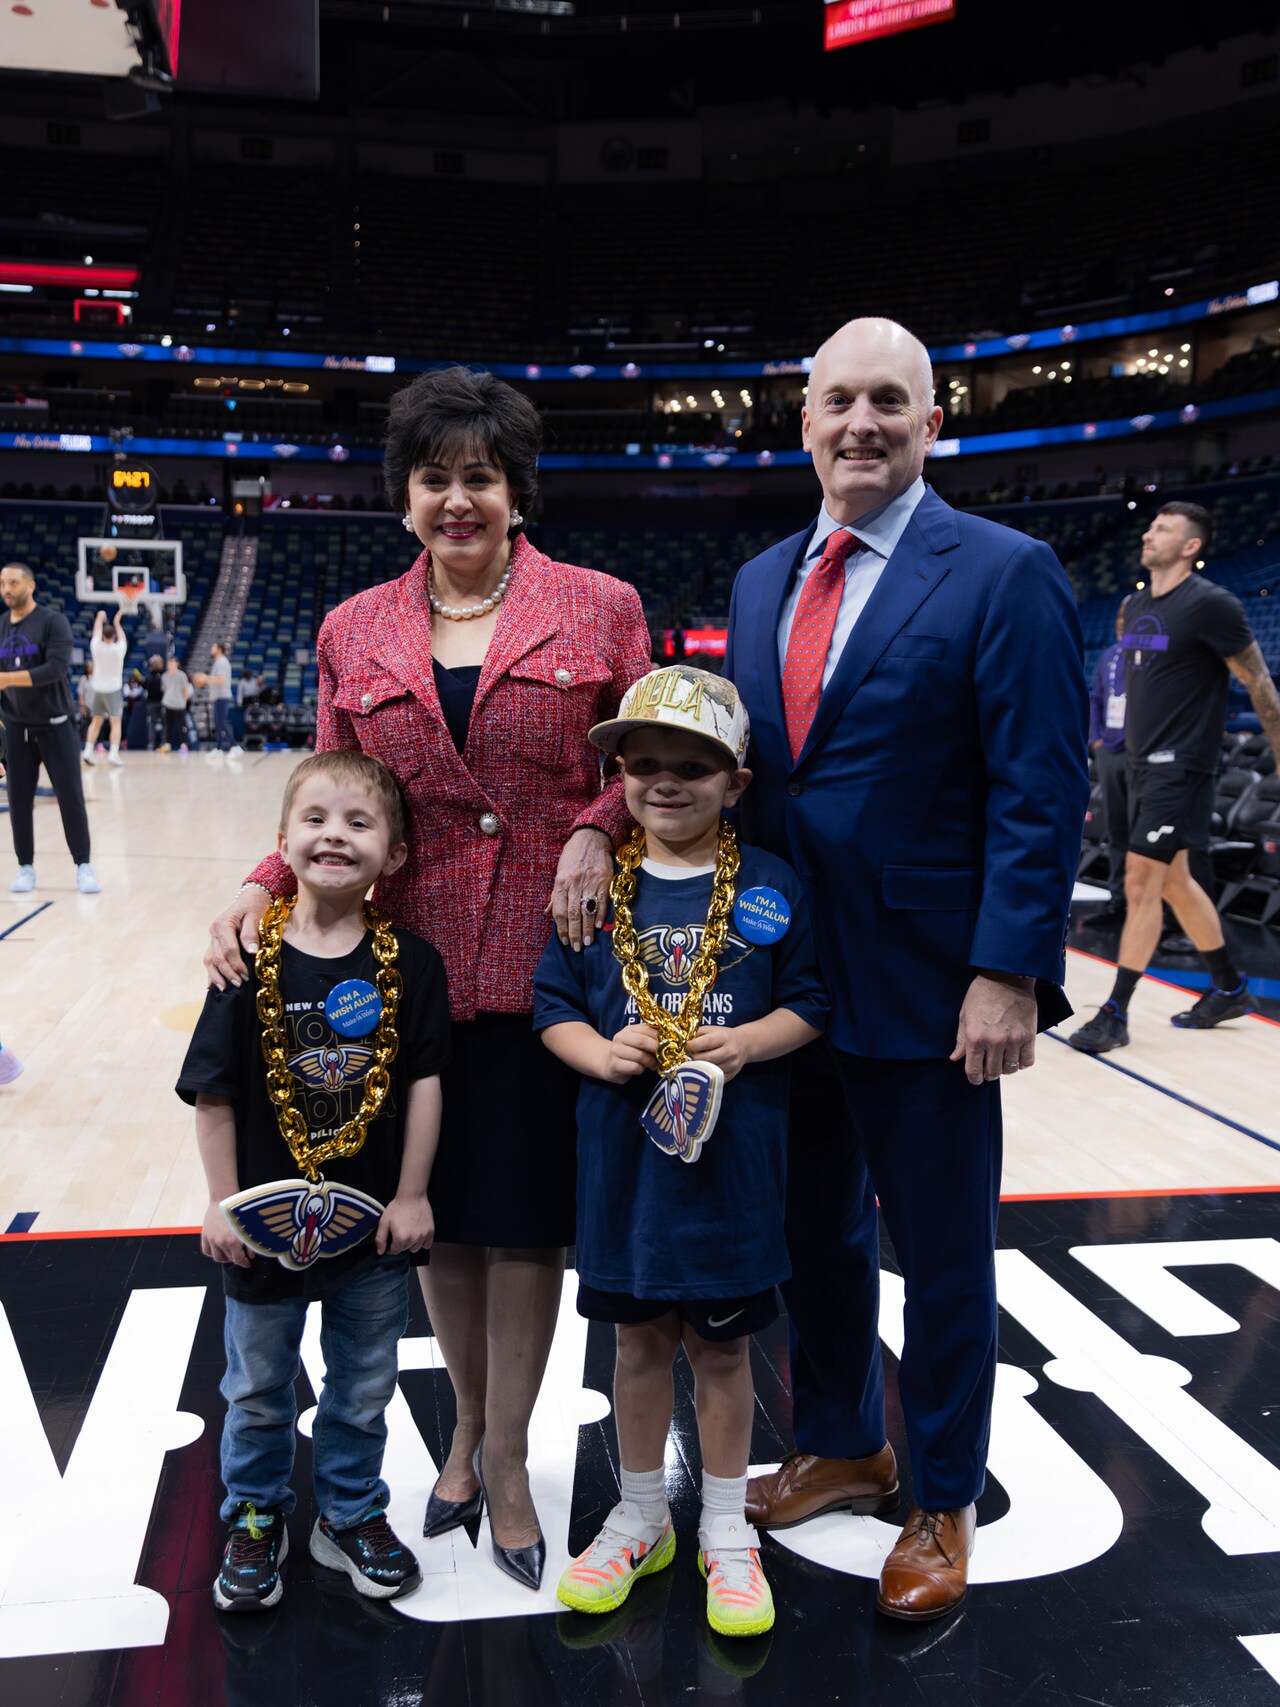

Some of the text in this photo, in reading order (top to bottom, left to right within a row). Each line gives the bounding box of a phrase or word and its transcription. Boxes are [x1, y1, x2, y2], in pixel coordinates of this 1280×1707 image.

[627, 671, 705, 721] NOLA
[739, 900, 790, 925] WISH ALUM
[755, 895, 777, 910] I'M A
[285, 1001, 313, 1012] NEW
[328, 1003, 354, 1021] WISH
[353, 991, 379, 1010] ALUM
[337, 993, 353, 1006] I'M
[352, 990, 361, 999] A
[661, 992, 733, 1014] ORANS
